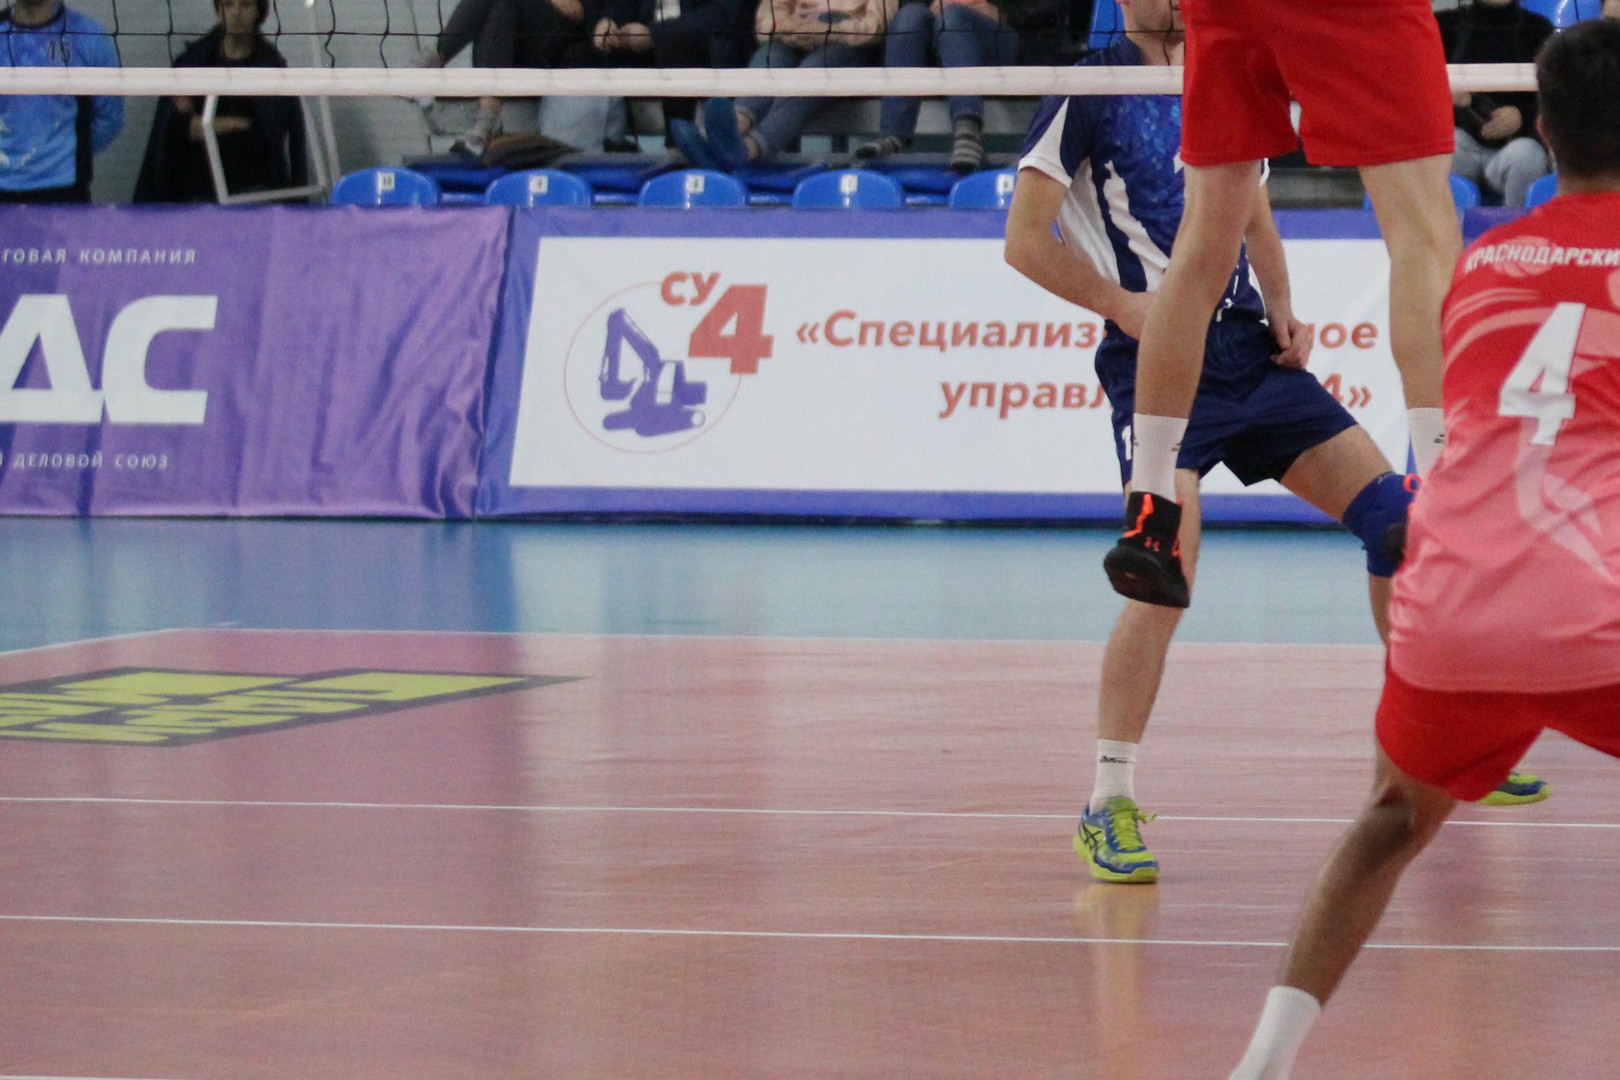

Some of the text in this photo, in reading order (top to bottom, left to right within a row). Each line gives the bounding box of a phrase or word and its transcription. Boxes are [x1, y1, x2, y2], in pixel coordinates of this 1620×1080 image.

[80, 247, 197, 265] КОМПАНИЯ
[1498, 301, 1588, 447] 4
[14, 452, 103, 469] ДЕЛОВОЙ
[115, 454, 169, 469] СОЮЗ
